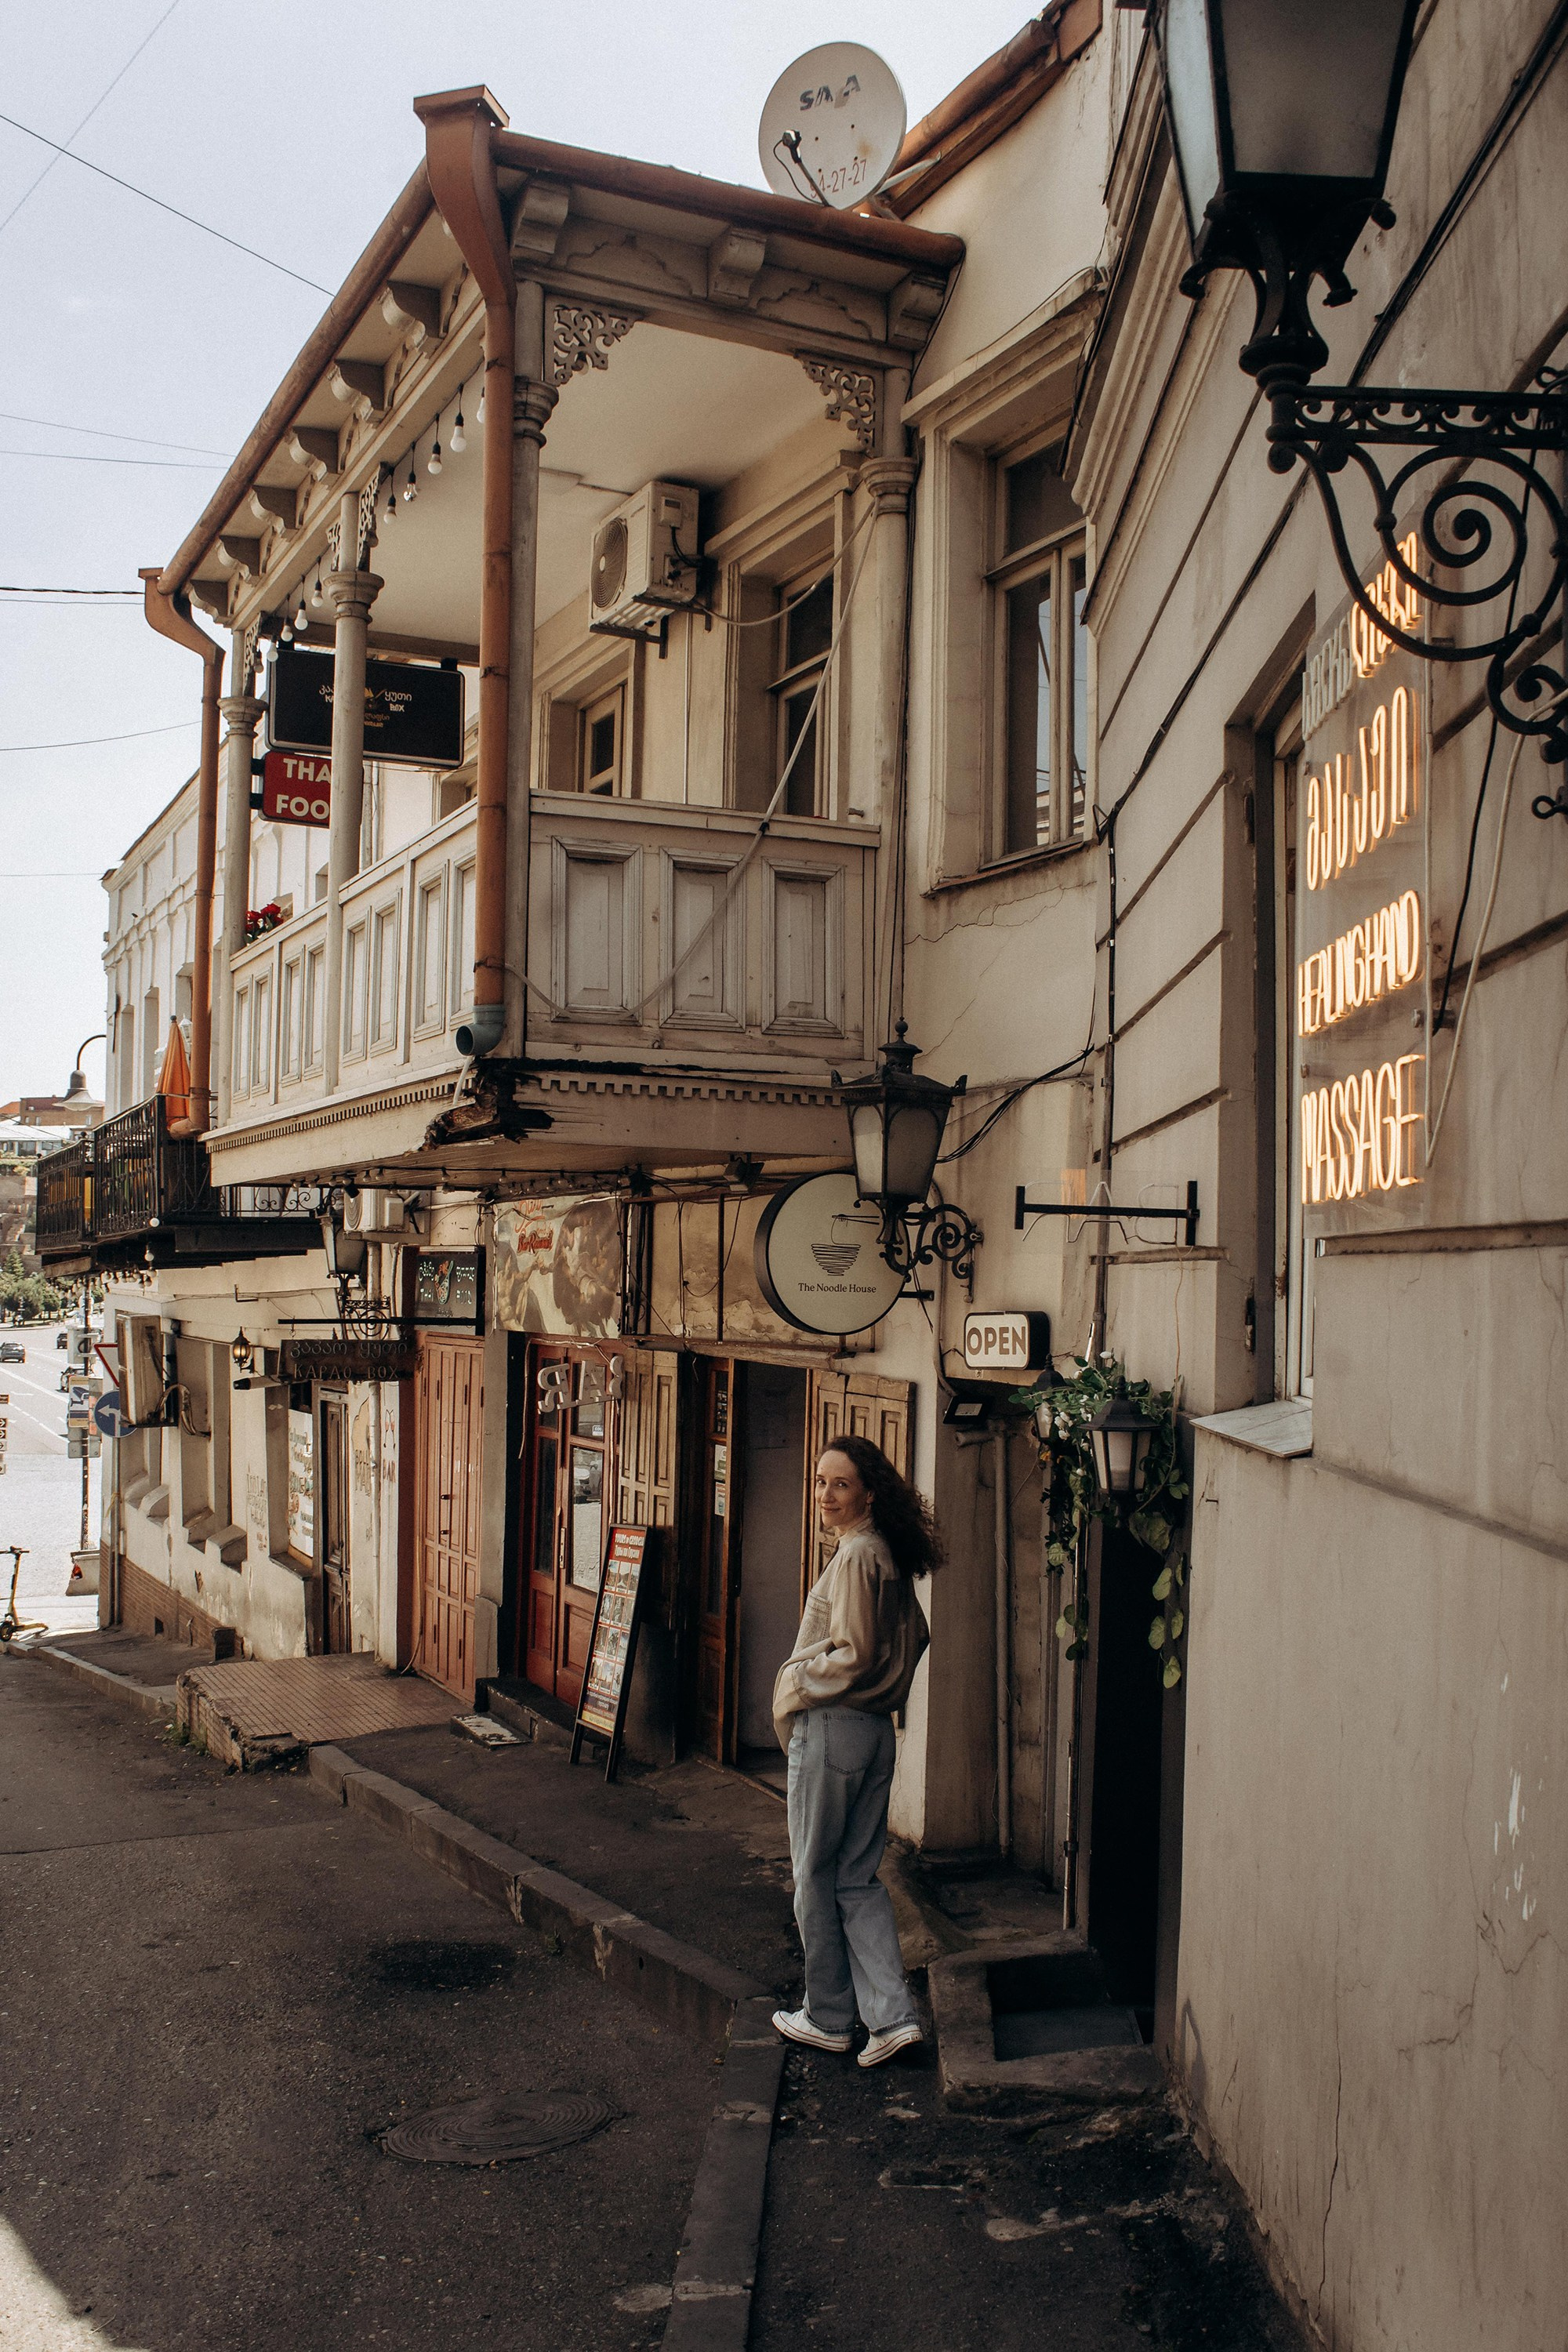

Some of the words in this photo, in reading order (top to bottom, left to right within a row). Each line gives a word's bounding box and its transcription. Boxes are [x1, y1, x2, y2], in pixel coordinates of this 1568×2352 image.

[283, 758, 331, 784] THA
[276, 794, 330, 820] FOO
[1301, 1054, 1425, 1203] MASSAGE
[798, 1283, 815, 1292] The
[816, 1283, 848, 1293] Noodle
[849, 1284, 877, 1293] House
[967, 1326, 1026, 1356] OPEN
[294, 1363, 352, 1379] KAPAO
[368, 1366, 399, 1380] BOX
